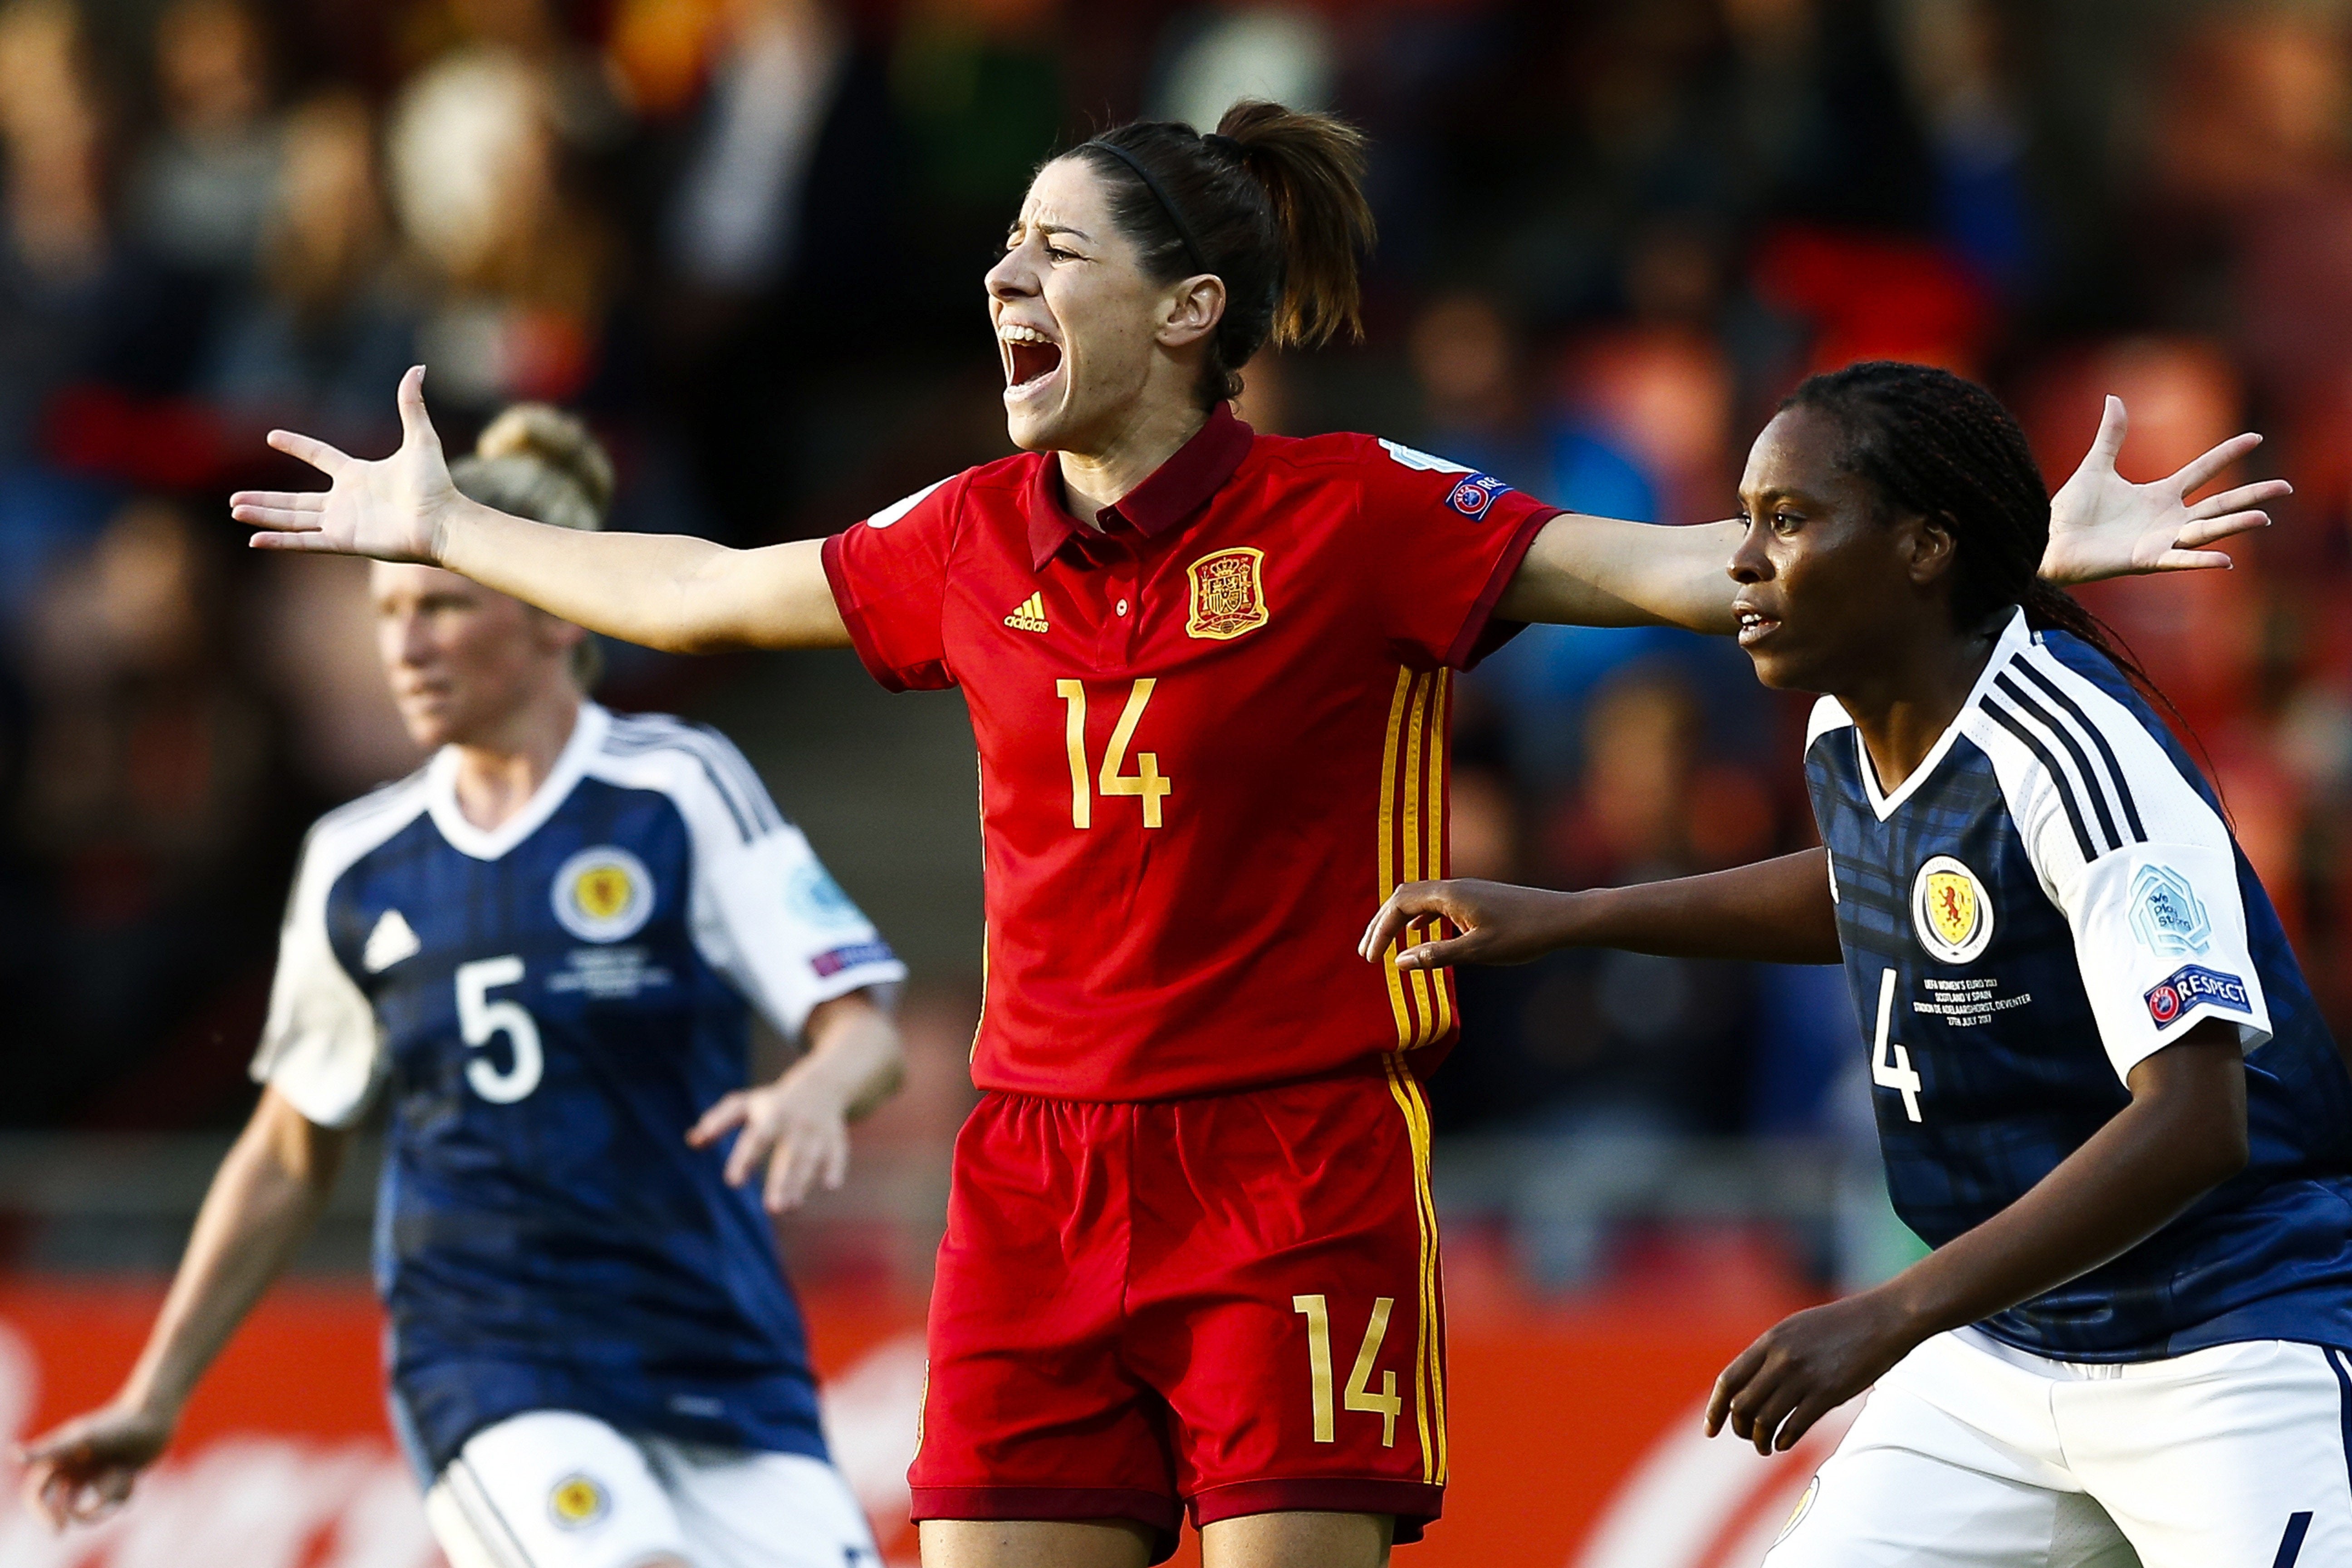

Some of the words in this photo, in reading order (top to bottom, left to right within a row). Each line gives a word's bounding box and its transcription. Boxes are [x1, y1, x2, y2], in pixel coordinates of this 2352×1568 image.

[1004, 615, 1049, 633] adidas
[1056, 678, 1171, 828] 14
[1924, 979, 1938, 990] UEFA
[1966, 979, 1984, 990] EURO
[1935, 992, 1965, 1002] SCOTLAND
[1971, 990, 1992, 1001] SPAIN
[2177, 975, 2245, 1003] RESPECT
[1995, 993, 2032, 1010] DEVENTER
[455, 954, 544, 1104] 5
[1962, 1016, 1977, 1027] JULY
[1872, 967, 1922, 1123] 4
[1292, 1294, 1401, 1448] 14
